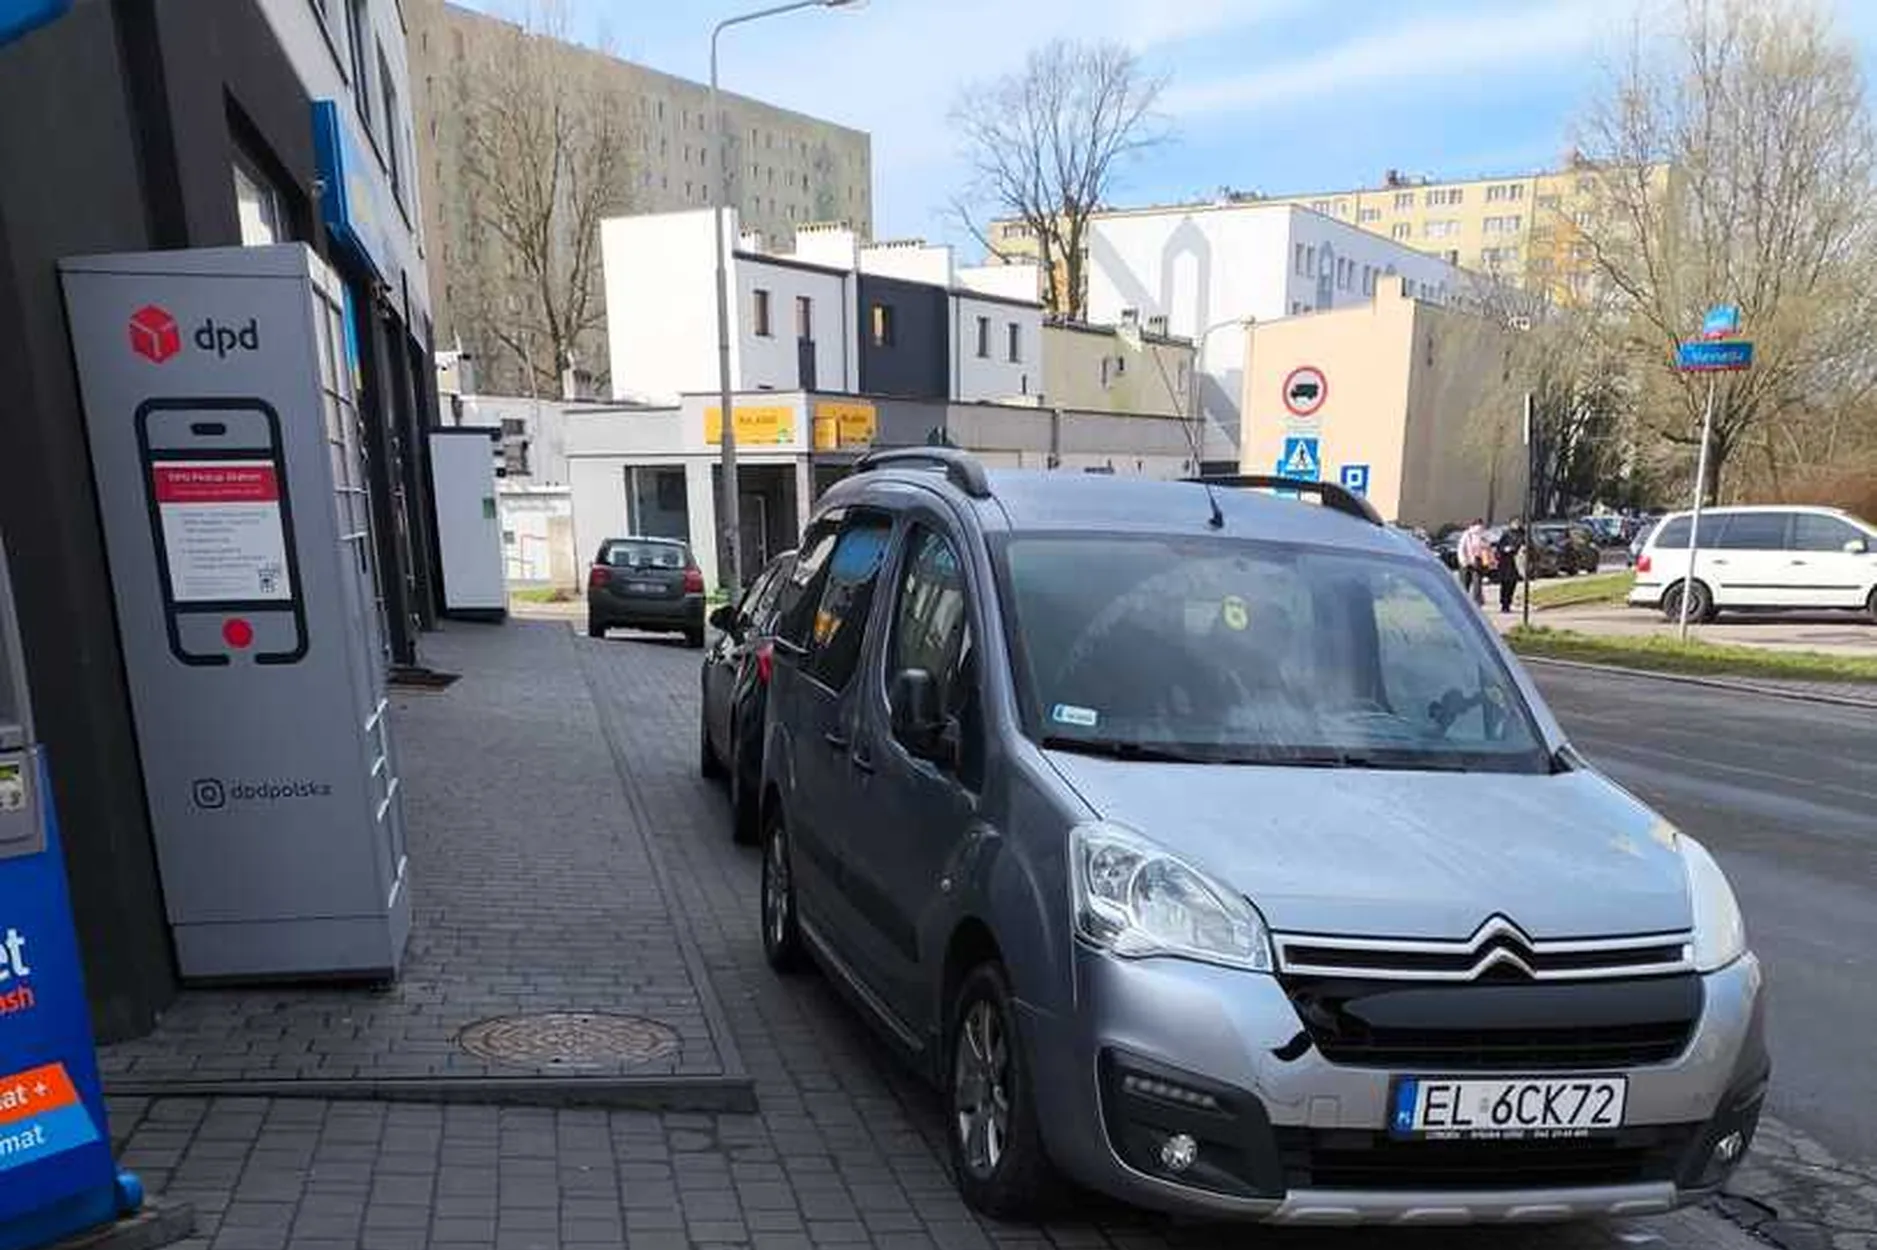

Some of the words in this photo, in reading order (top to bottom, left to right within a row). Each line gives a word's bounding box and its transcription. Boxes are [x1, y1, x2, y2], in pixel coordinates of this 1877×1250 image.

[194, 317, 259, 358] dpd
[0, 1085, 28, 1110] at
[1423, 1085, 1473, 1125] EL
[1491, 1084, 1615, 1124] 6CK72
